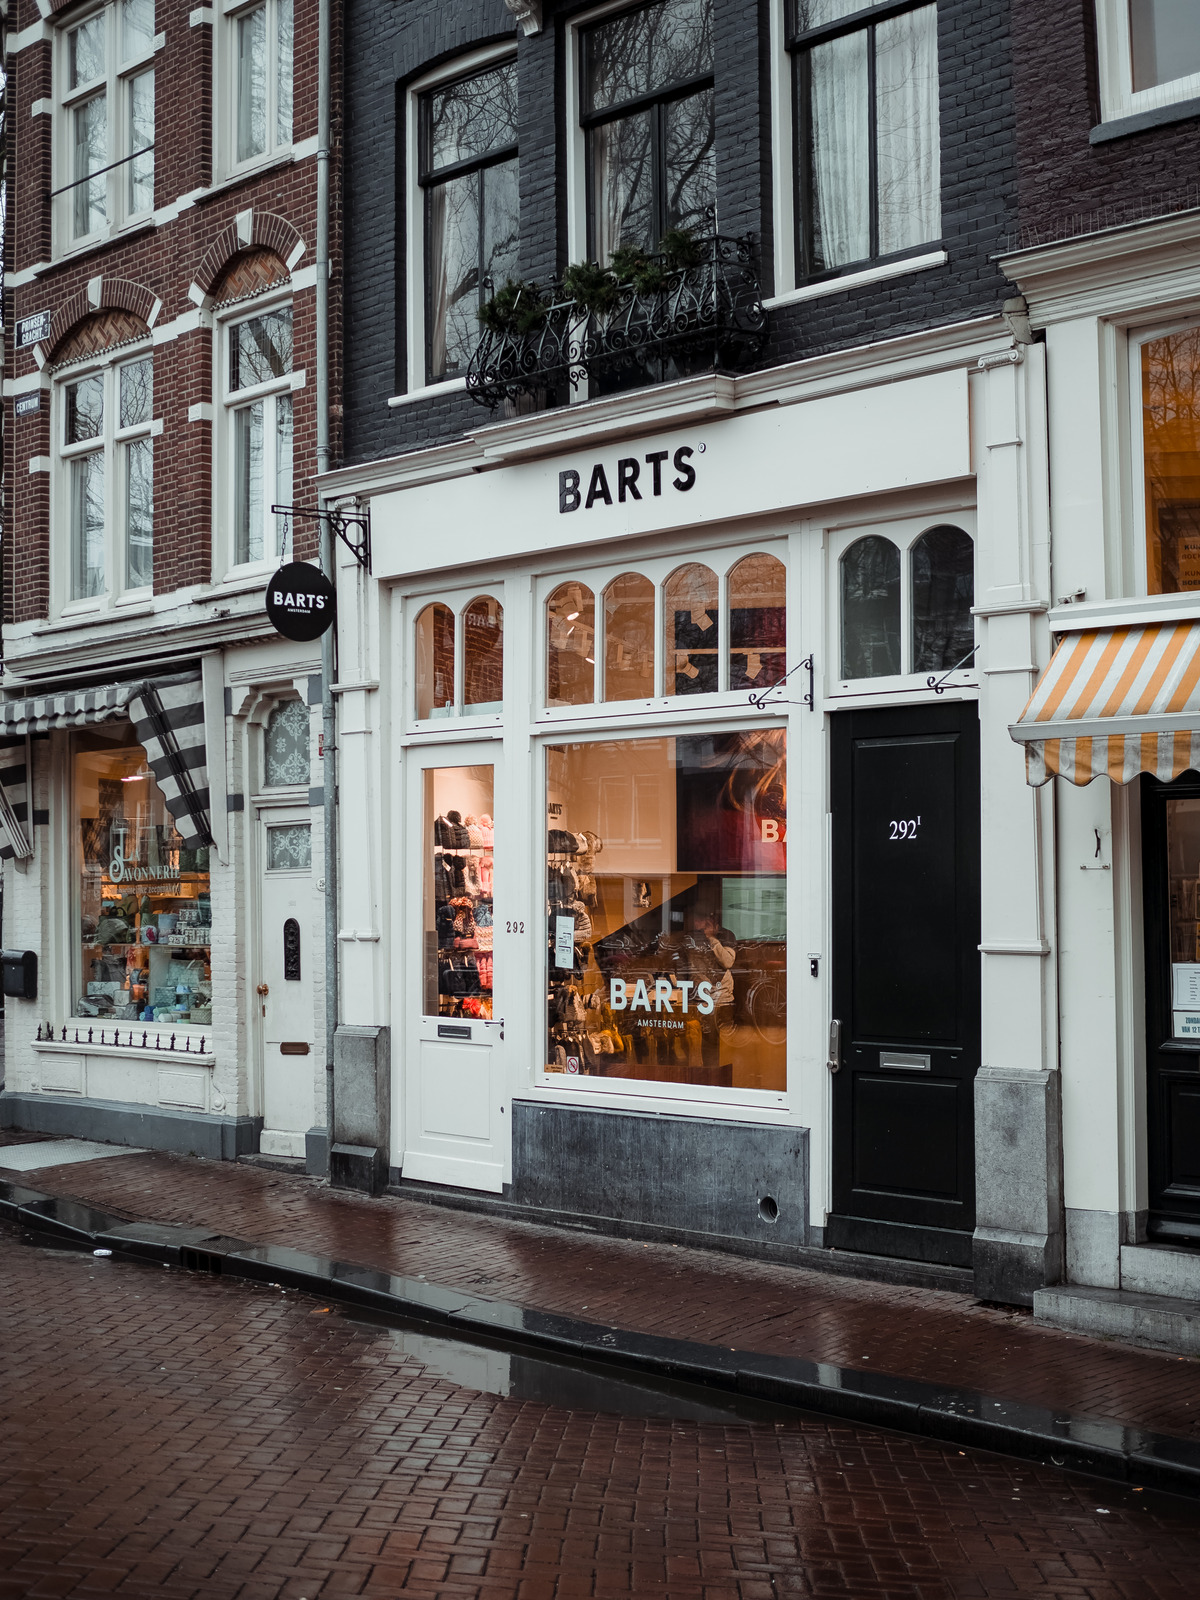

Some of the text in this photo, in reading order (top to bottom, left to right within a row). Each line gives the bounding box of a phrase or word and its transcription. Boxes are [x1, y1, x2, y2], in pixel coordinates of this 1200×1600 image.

[16, 397, 39, 413] CENTRUM
[506, 920, 525, 934] 292
[637, 1019, 684, 1029] AMSTERDAM
